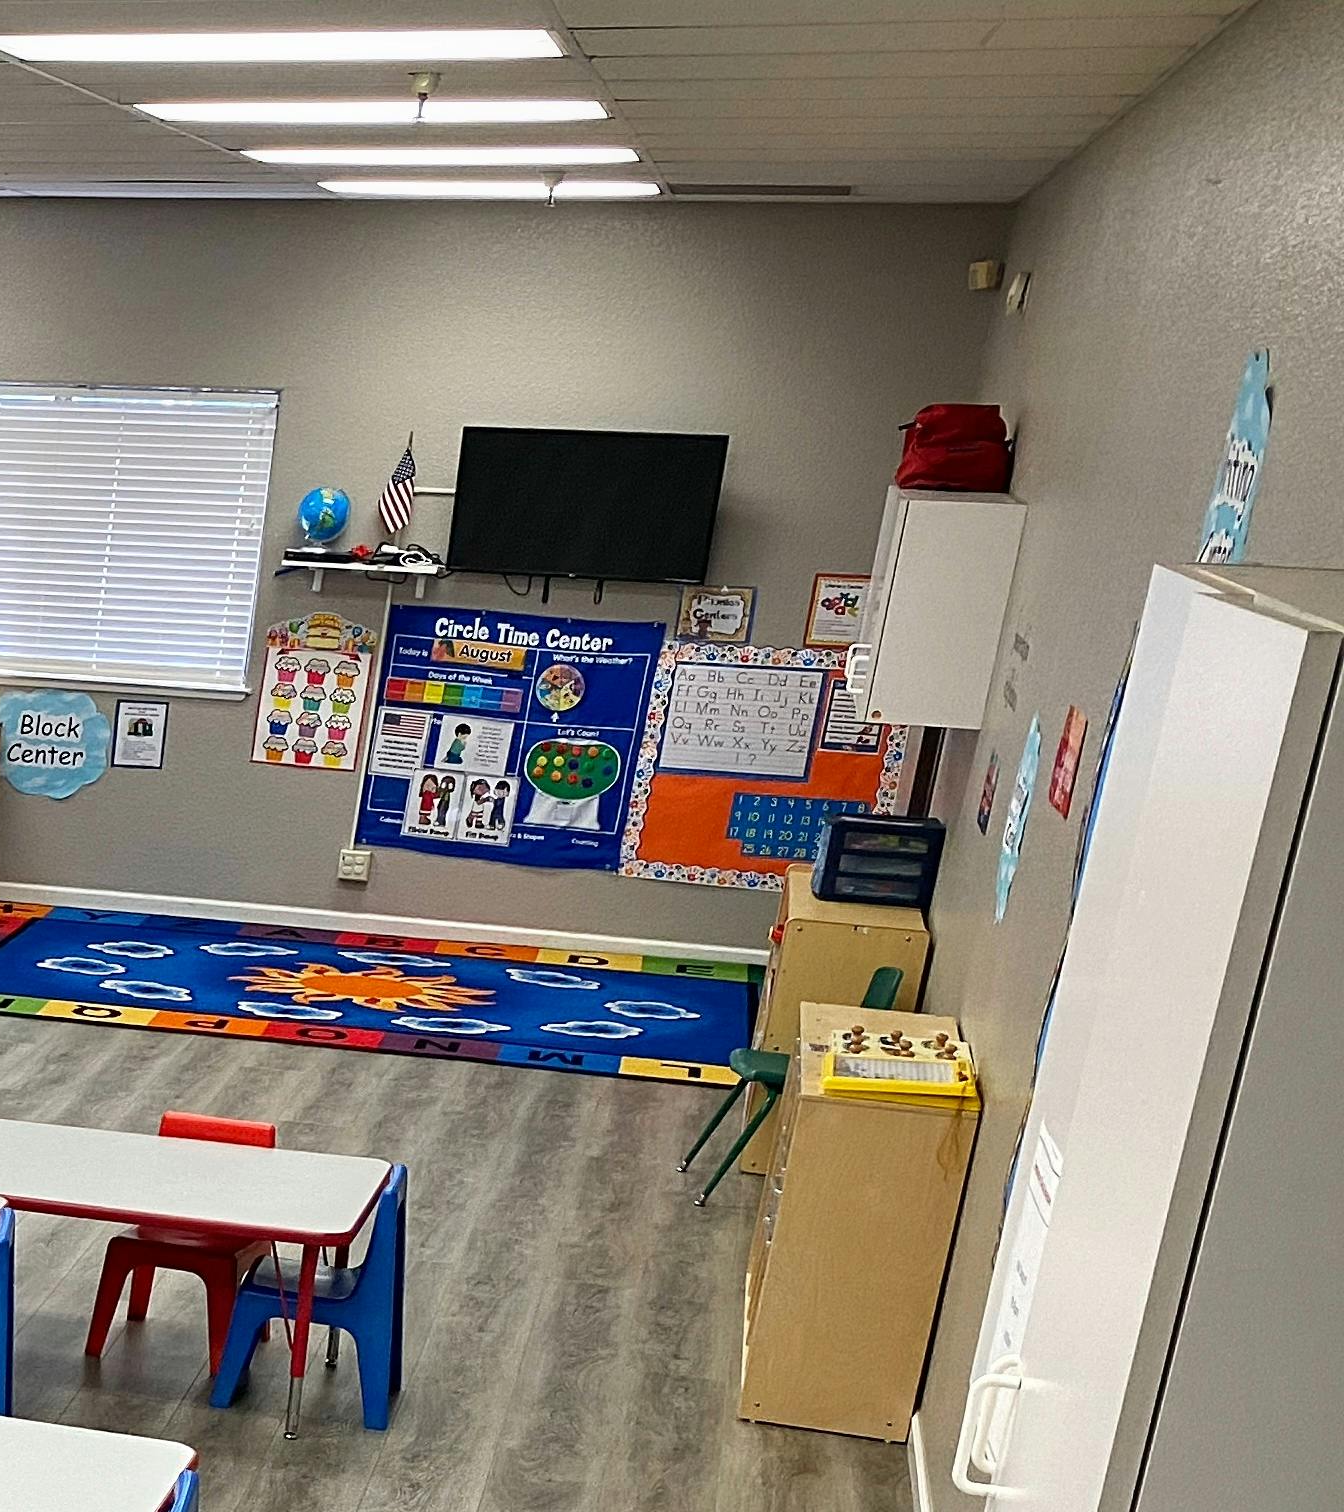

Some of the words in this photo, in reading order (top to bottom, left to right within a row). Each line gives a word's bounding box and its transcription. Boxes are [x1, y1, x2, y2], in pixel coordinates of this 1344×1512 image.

[435, 617, 490, 641] Circle
[498, 623, 540, 646] Time
[546, 628, 613, 652] Center
[459, 645, 512, 663] August
[428, 671, 446, 681] Days
[458, 673, 471, 682] the
[472, 675, 492, 685] Week
[677, 669, 696, 681] Aa
[708, 670, 725, 683] Bb
[736, 671, 754, 685] Cc
[768, 673, 788, 687] Dd
[799, 675, 817, 688] Ee
[676, 684, 692, 697] Ff
[697, 686, 717, 704] Gg
[726, 688, 744, 700] Hh
[696, 702, 720, 715] Mm
[730, 704, 749, 717] Nn
[757, 705, 778, 718] Oo
[792, 707, 809, 725] Pp
[20, 714, 80, 738] Block
[704, 719, 720, 731] Rr
[732, 720, 745, 733] Ss
[789, 724, 807, 737] Uu
[671, 733, 689, 745] Vv
[698, 734, 724, 748] Ww
[733, 736, 750, 750] Xx
[762, 739, 777, 756] Yy
[785, 740, 807, 753] Zz
[7, 743, 84, 766] Center
[748, 753, 757, 765] ?
[739, 795, 743, 805] 1
[753, 797, 761, 807] 2
[770, 798, 778, 807] 3
[788, 799, 795, 809] 4
[805, 799, 812, 810] 5
[822, 801, 830, 811] 6
[841, 802, 847, 813] 7
[858, 802, 866, 814] 8
[734, 811, 741, 820] 9
[747, 812, 760, 822] 10
[784, 814, 793, 824] 12
[800, 816, 810, 826] 13
[729, 827, 739, 837] 17
[745, 828, 756, 838] 18
[763, 829, 773, 839] 19
[778, 830, 793, 841] 20
[798, 831, 808, 842] 21
[744, 844, 755, 853] 25
[759, 844, 771, 855] 26
[777, 846, 789, 857] 27
[794, 847, 807, 858] 28
[265, 928, 305, 939] A
[365, 936, 406, 948] B
[465, 945, 507, 956] C
[567, 954, 609, 966] D
[675, 964, 714, 976] E
[71, 1004, 123, 1019] Q
[184, 1019, 229, 1030] P
[295, 1027, 347, 1041] O
[413, 1038, 462, 1053] N
[527, 1050, 585, 1066] M
[660, 1062, 702, 1079] L
